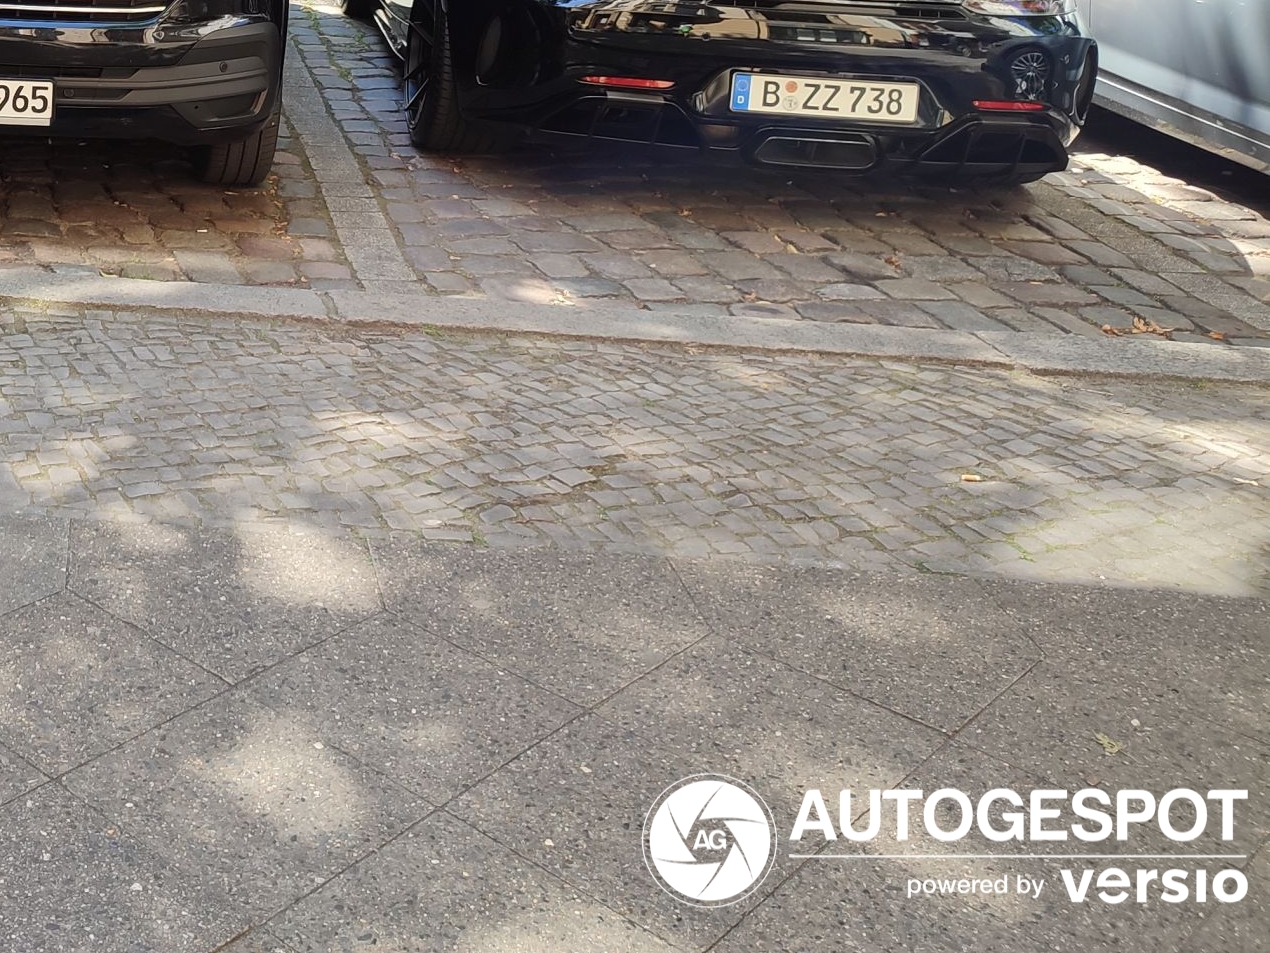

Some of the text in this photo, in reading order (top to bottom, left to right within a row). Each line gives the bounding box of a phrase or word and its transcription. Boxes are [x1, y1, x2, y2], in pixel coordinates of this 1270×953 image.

[737, 95, 745, 104] D
[762, 81, 903, 115] B ZZ 738
